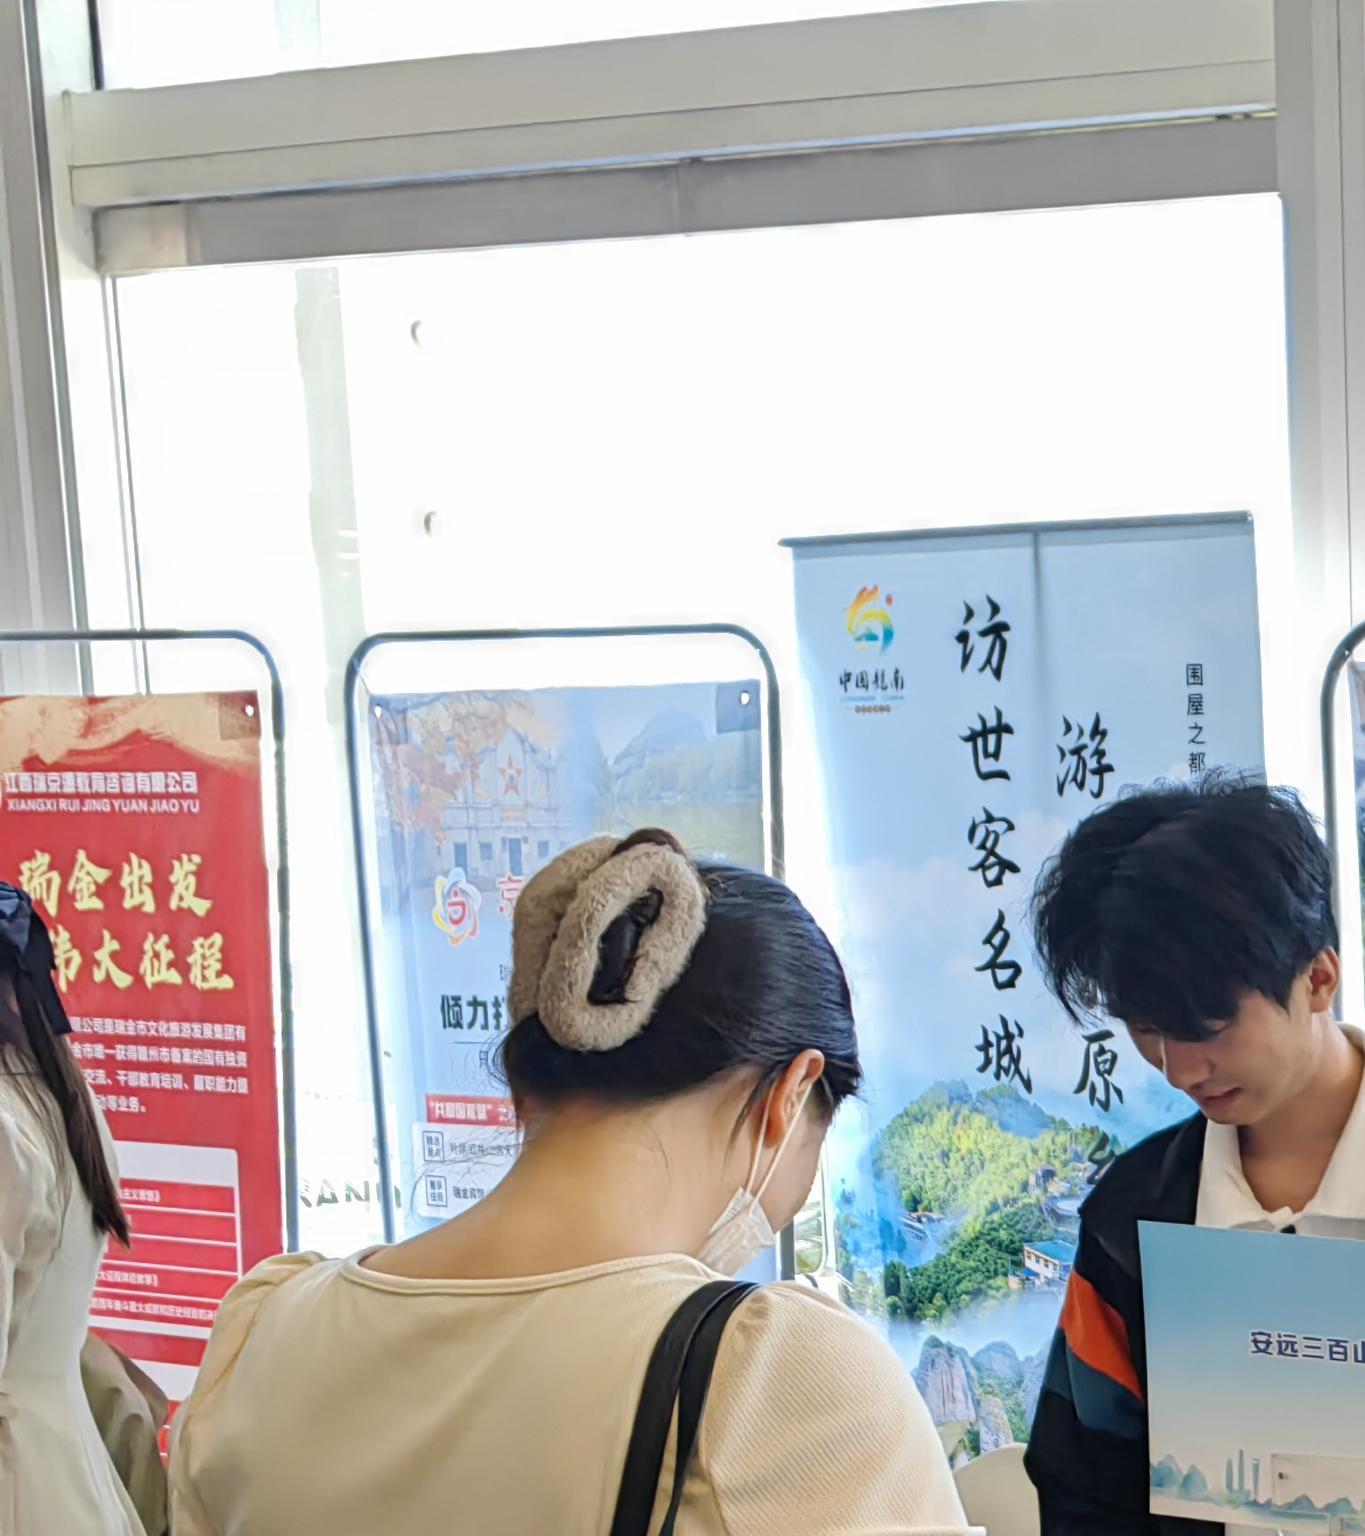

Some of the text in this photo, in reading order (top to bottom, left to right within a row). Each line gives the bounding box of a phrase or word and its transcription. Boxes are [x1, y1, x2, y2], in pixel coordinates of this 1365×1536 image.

[1186, 663, 1206, 774] 围屋之都
[59, 799, 80, 813] RUI
[82, 799, 111, 814] JING
[114, 799, 148, 813] YUAN
[150, 799, 179, 813] JIAO
[181, 799, 200, 813] YU
[954, 594, 1033, 1095] 访世客名城
[18, 849, 213, 918] 瑞金出发
